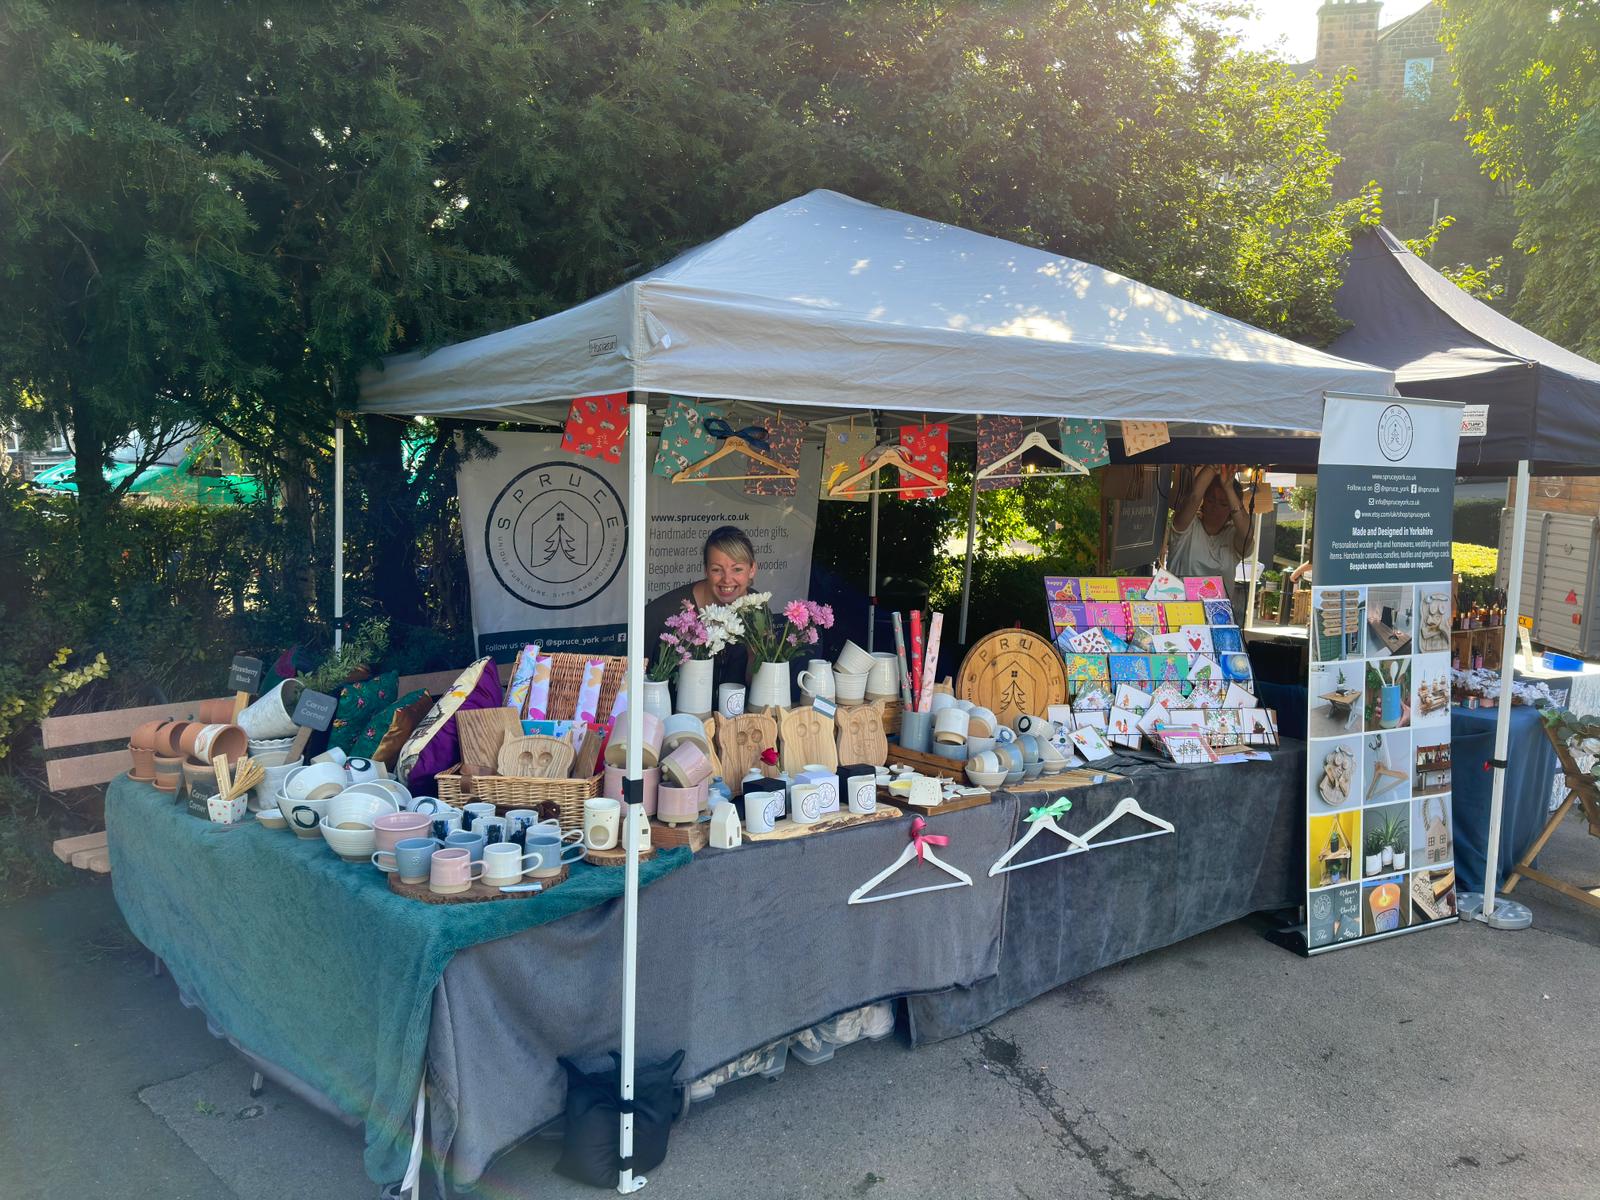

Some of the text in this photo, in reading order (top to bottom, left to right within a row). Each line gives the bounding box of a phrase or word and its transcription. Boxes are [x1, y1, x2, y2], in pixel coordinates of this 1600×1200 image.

[497, 473, 619, 530] SPRUCE
[651, 512, 750, 524] www.spruceyork.co.uk
[649, 527, 696, 540] Handmade
[745, 526, 768, 538] ooden
[770, 526, 789, 540] gifts,
[1352, 527, 1433, 538] Made and Designed in Yorkshire
[497, 536, 510, 568] UNIQUE
[649, 545, 698, 558] homewares
[648, 559, 788, 576] Bespoke and wooden
[1350, 562, 1367, 571] Bespoke
[648, 579, 695, 592] items mad
[485, 643, 508, 652] Follow
[546, 636, 600, 648] @spruce_york
[602, 634, 615, 642] and
[967, 637, 1062, 687] SPRUCE
[232, 664, 258, 678] Strawberry
[305, 700, 329, 712] Carrot
[301, 708, 326, 720] Corner
